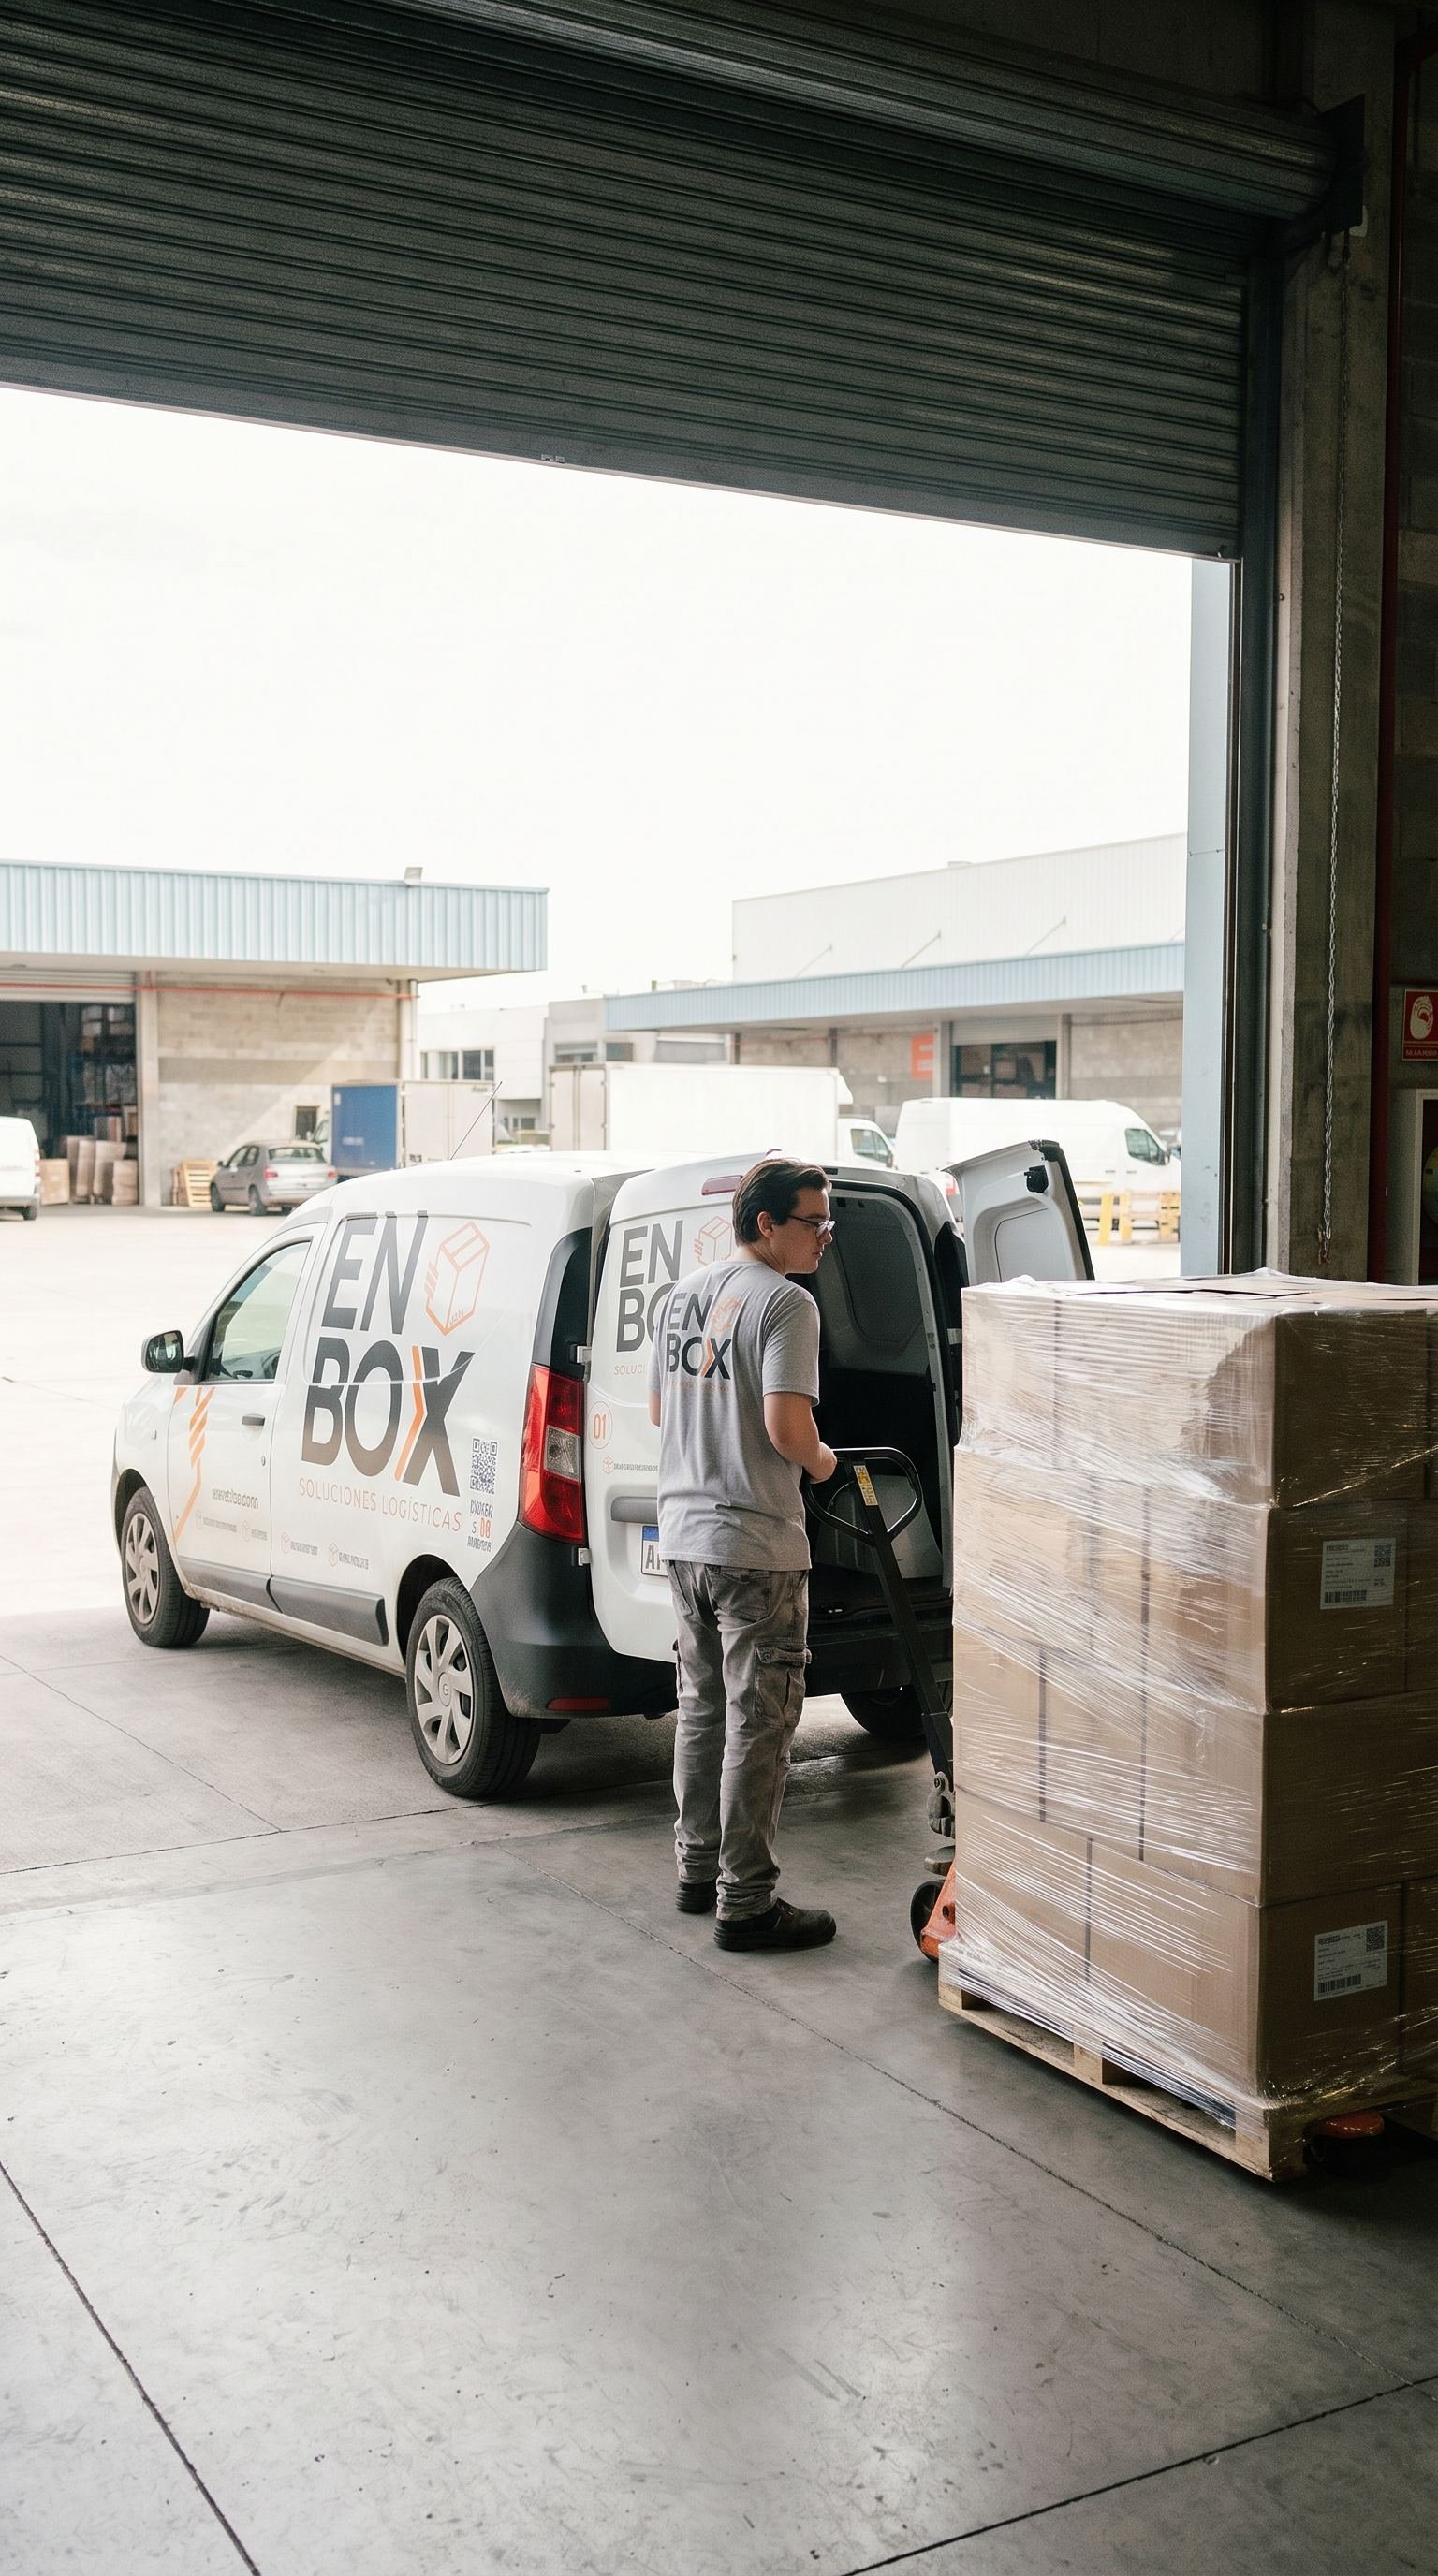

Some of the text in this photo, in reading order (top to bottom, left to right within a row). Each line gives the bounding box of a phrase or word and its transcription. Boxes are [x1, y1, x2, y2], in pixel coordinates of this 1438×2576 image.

[321, 1211, 428, 1335] EN
[620, 1221, 683, 1288] EN
[667, 1293, 714, 1332] EN
[666, 1333, 732, 1380] BOX
[301, 1337, 476, 1497] BOX
[593, 1413, 607, 1439] 01
[299, 1477, 377, 1512] SOLUCIONES
[382, 1495, 462, 1532] LOGÍSTICAS
